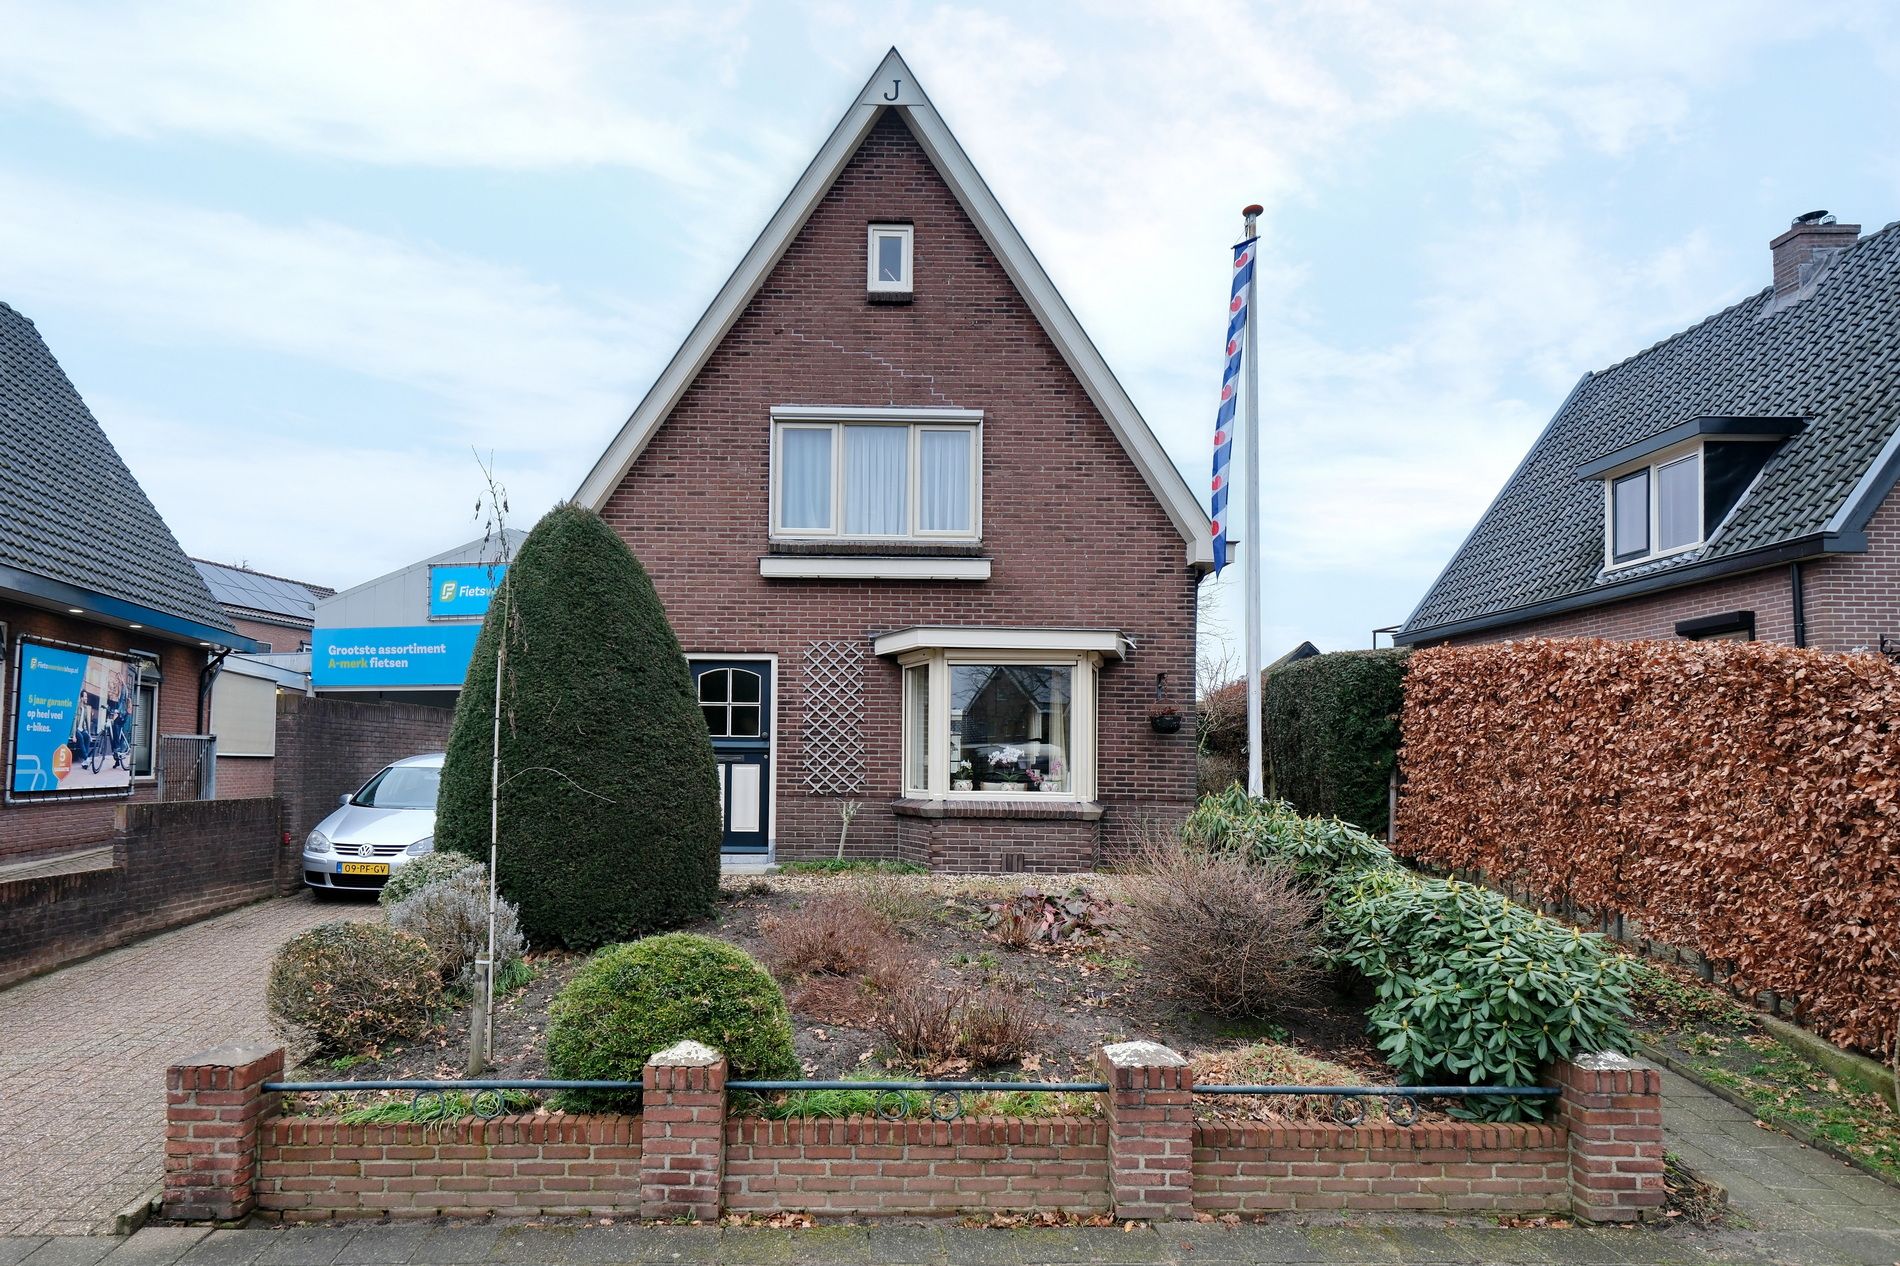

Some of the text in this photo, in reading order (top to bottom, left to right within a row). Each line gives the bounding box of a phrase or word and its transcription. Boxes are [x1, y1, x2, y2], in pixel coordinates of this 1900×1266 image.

[884, 80, 901, 101] J
[328, 642, 446, 656] Grootste assortiment
[328, 656, 408, 669] A-merk fietsen
[33, 694, 47, 706] jaar
[47, 697, 73, 708] garantie
[27, 708, 64, 720] op heel veel
[26, 721, 52, 733] e-bikes.
[59, 748, 66, 762] 5
[344, 863, 387, 873] 09-PF-GV
